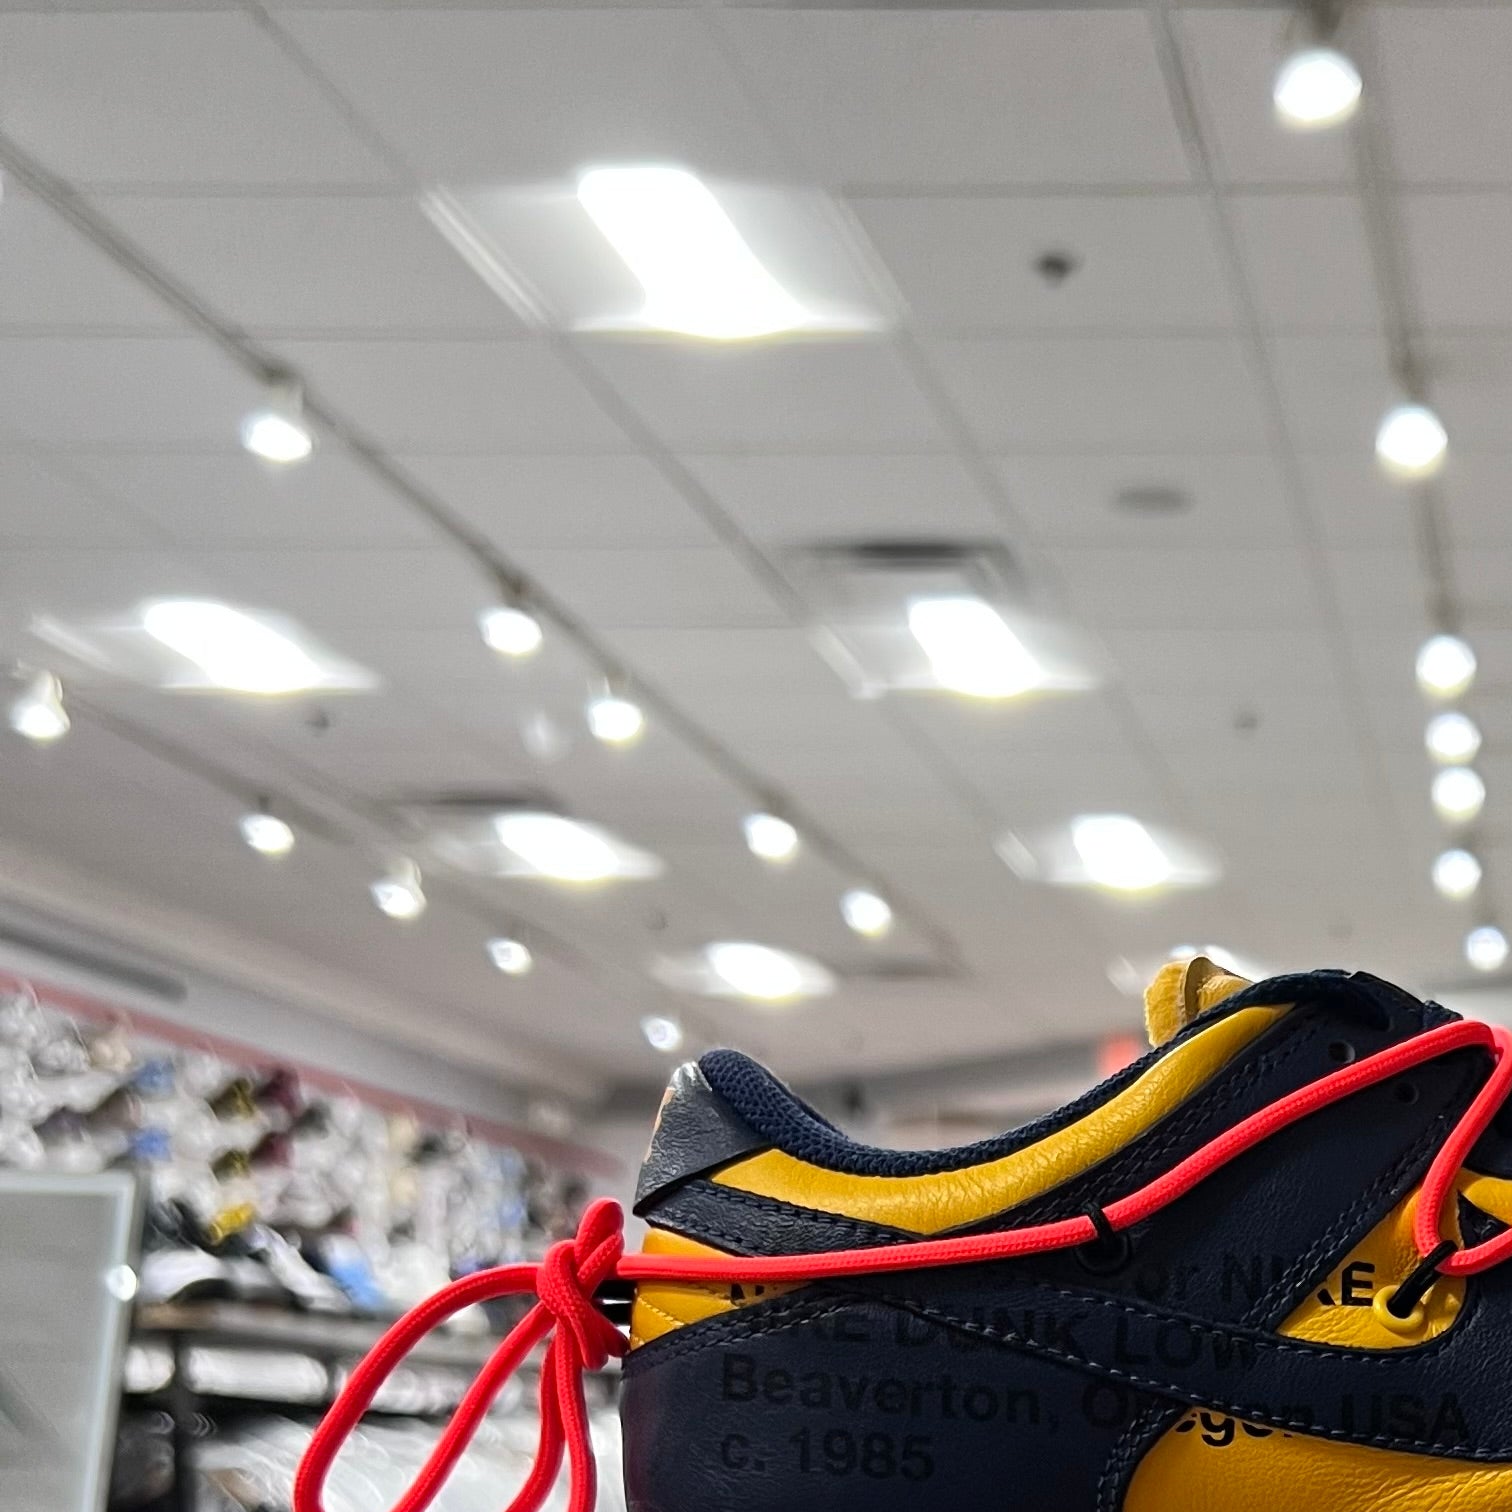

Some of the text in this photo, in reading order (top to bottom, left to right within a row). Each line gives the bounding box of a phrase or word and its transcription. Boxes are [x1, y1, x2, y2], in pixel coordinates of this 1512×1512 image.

[1221, 1253, 1376, 1307] NIE
[1114, 1315, 1262, 1370] LOW
[721, 1352, 1060, 1433] Beaverton,
[1341, 1392, 1470, 1442] USA
[720, 1426, 935, 1482] c. 1985
